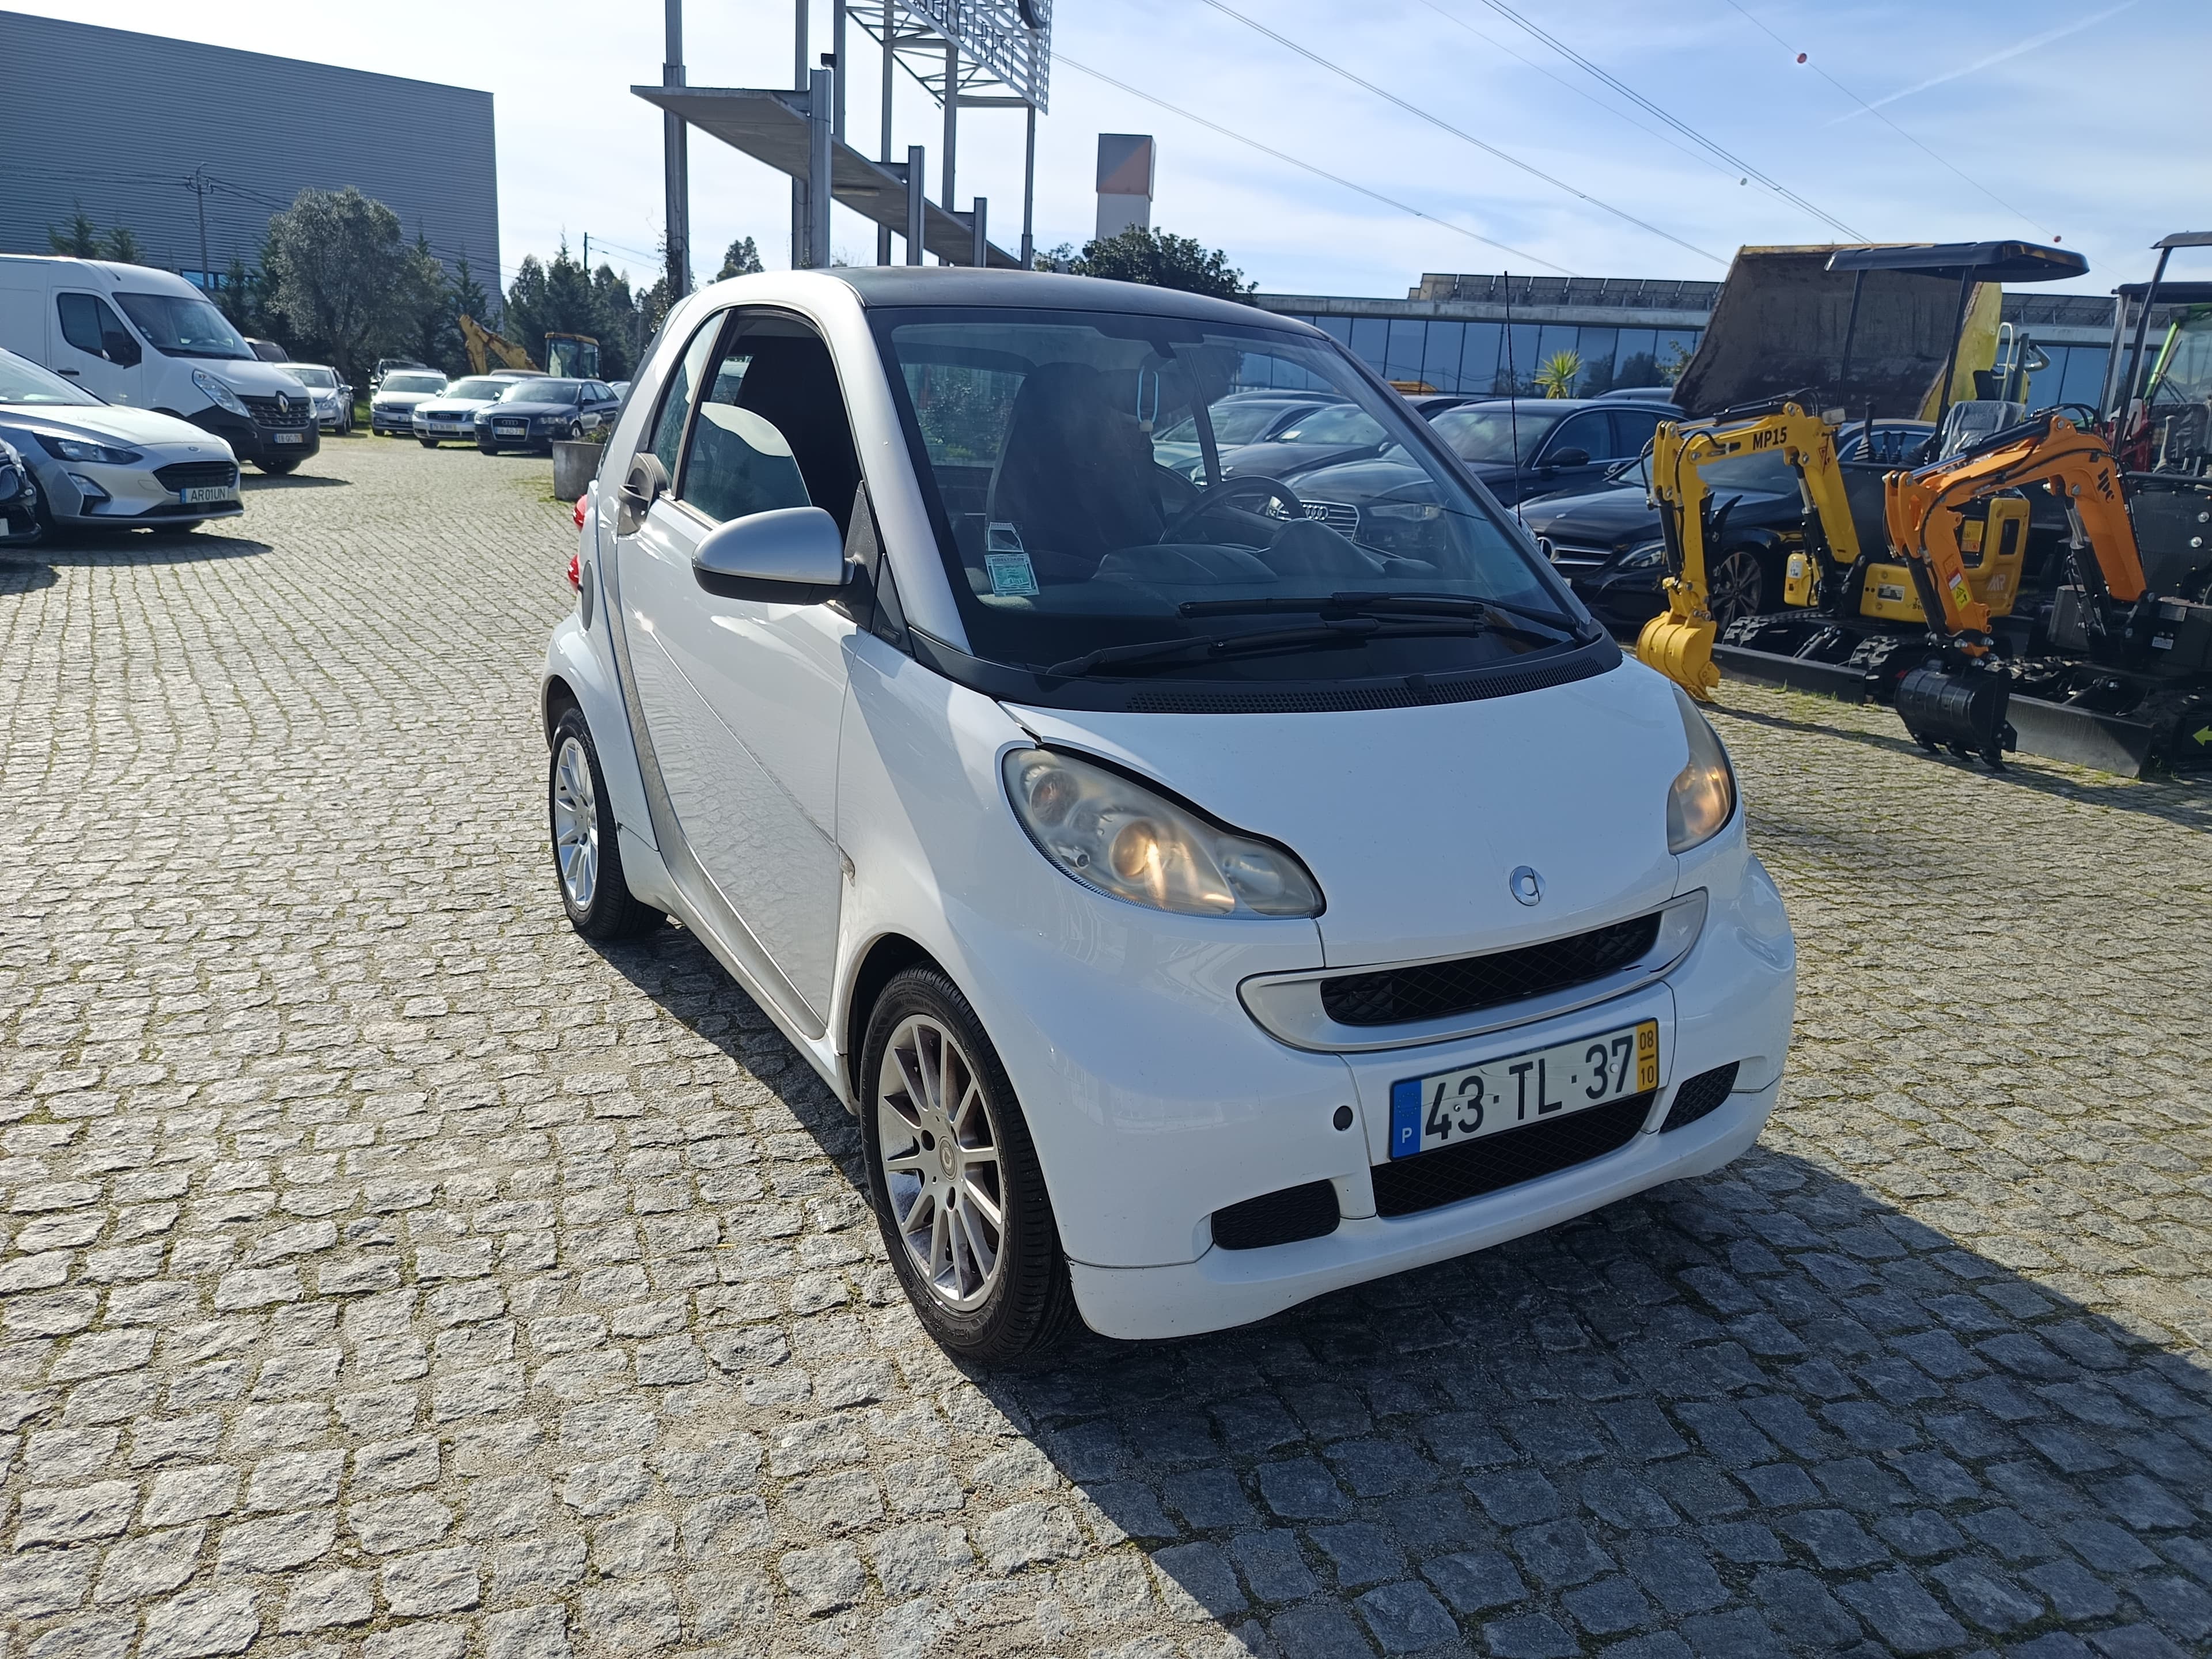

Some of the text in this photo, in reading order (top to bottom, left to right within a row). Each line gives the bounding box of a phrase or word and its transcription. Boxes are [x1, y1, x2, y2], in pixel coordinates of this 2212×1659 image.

[1753, 426, 1787, 450] MP15
[1639, 1031, 1654, 1050] 08
[1641, 1065, 1654, 1085] 10
[1402, 1127, 1412, 1143] P
